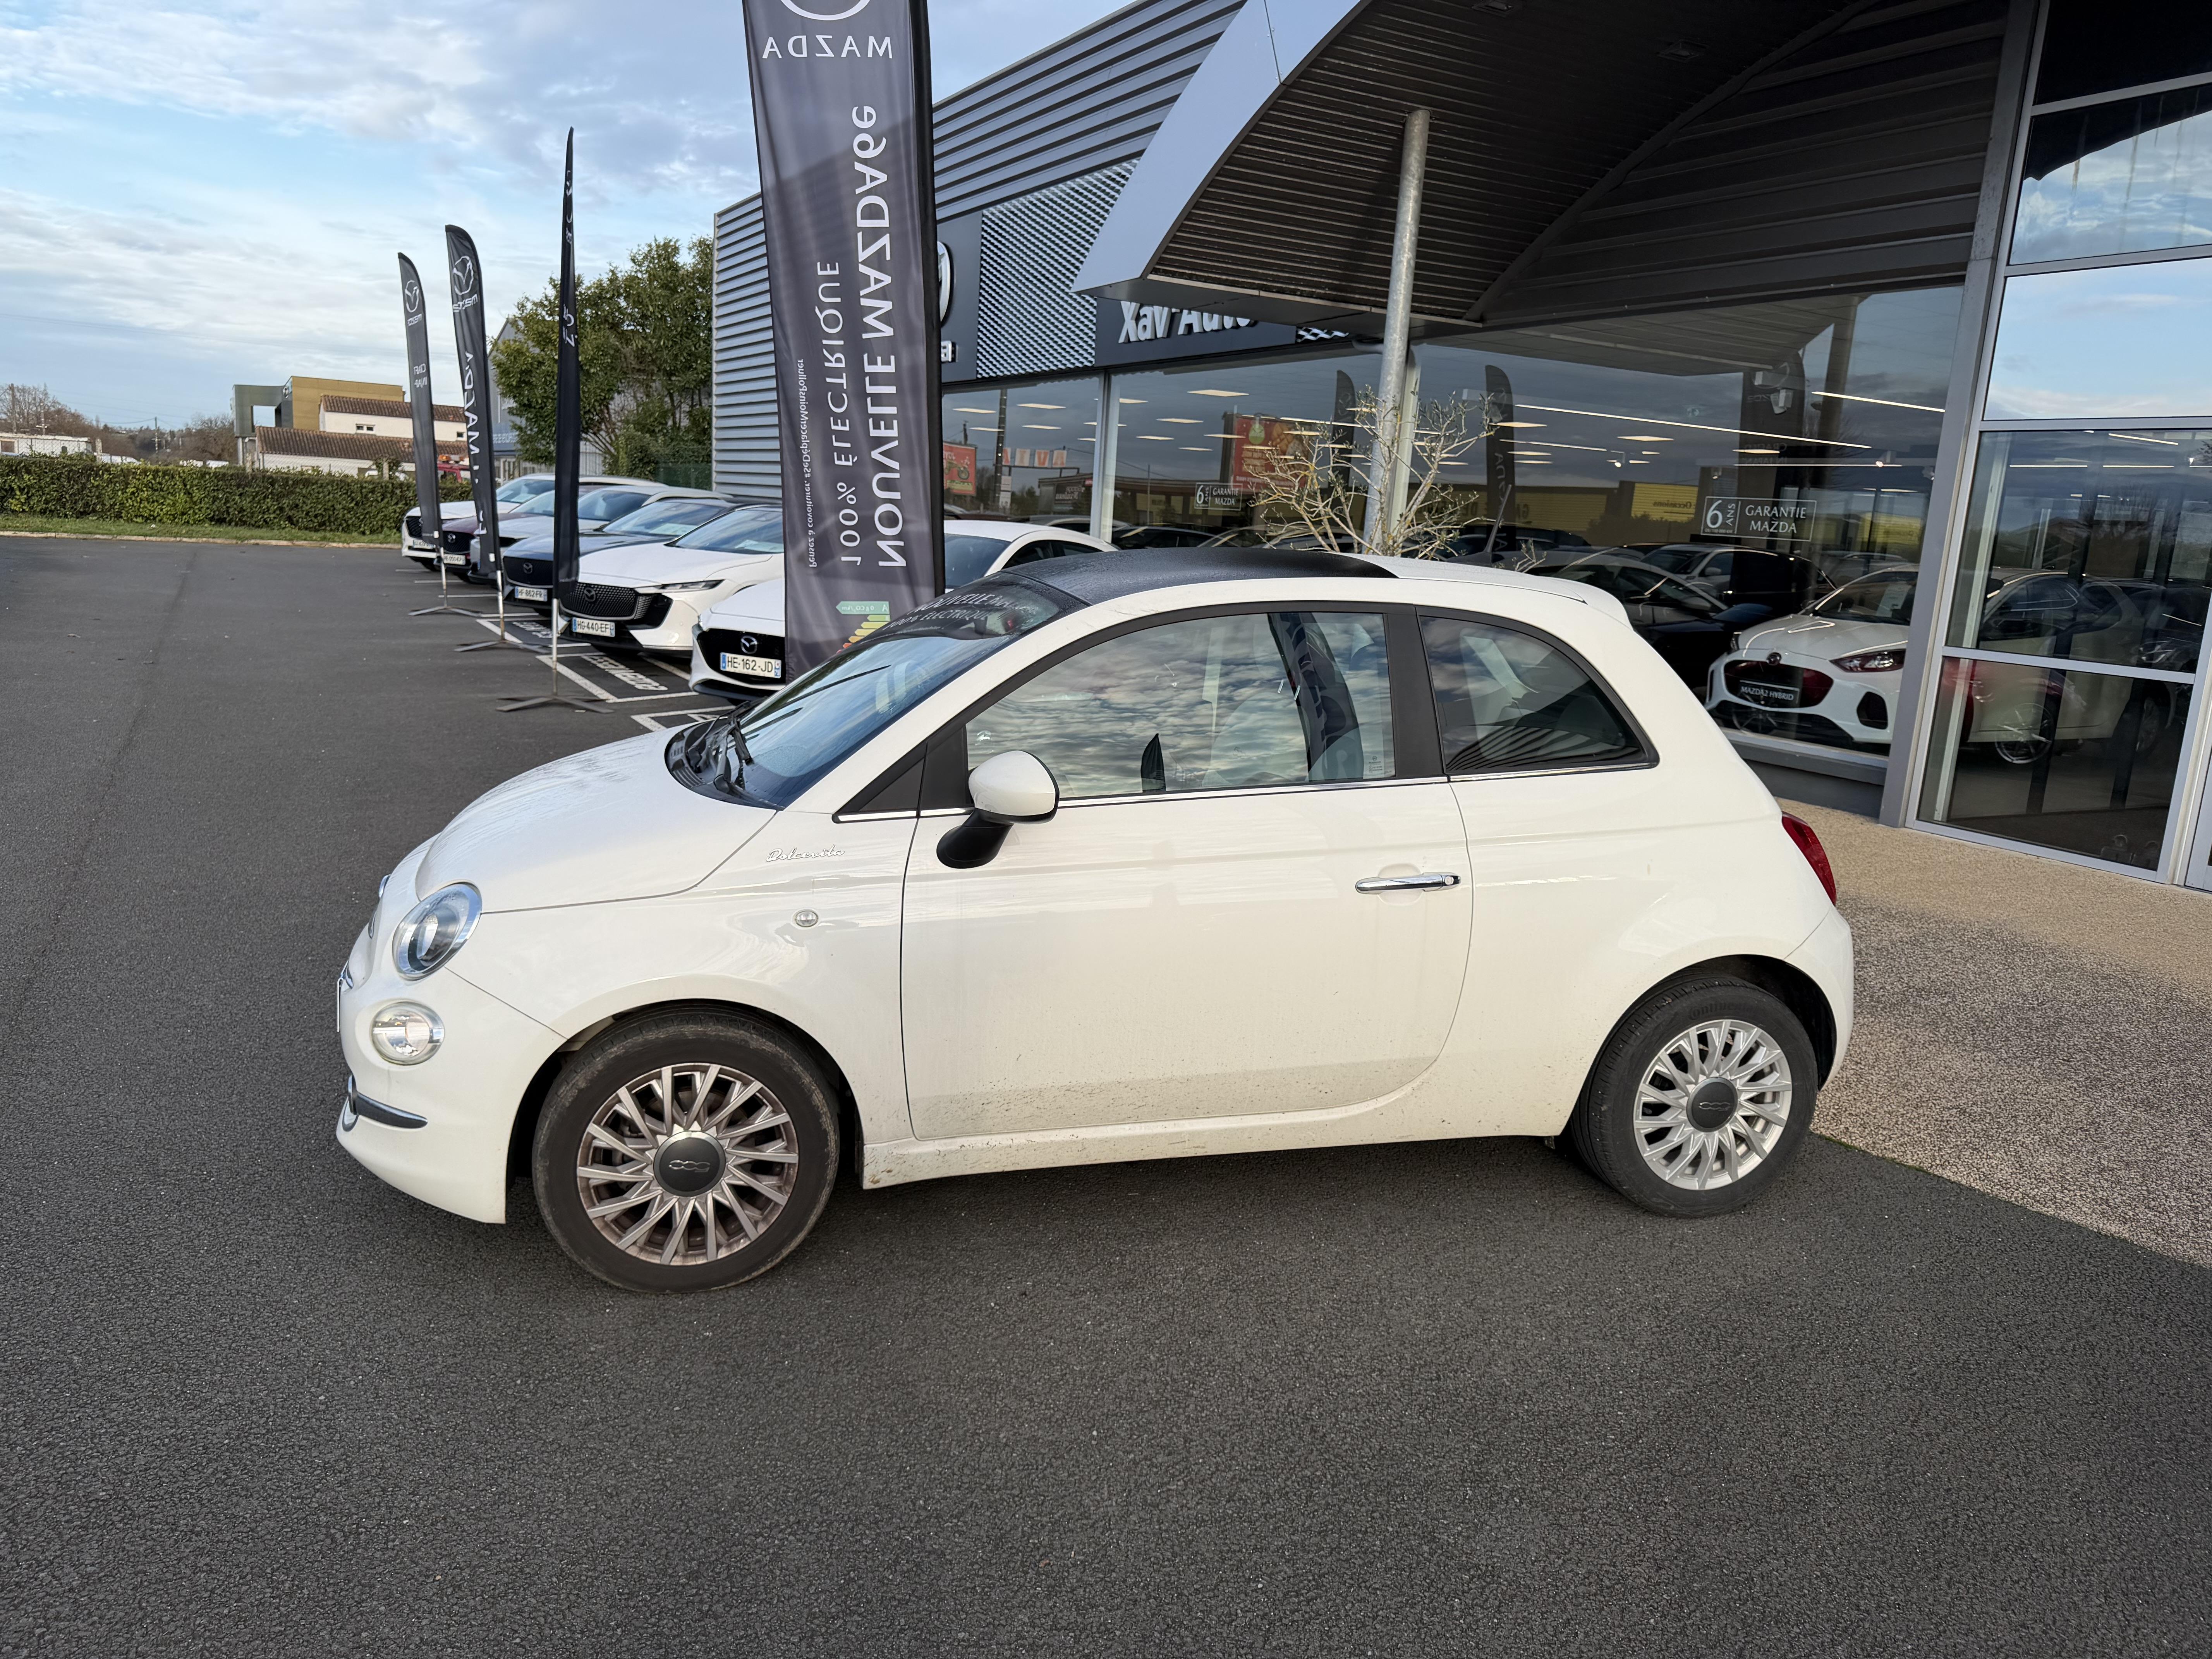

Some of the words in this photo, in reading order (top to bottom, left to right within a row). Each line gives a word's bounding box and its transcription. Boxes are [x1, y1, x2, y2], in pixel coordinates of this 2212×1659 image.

[1118, 301, 1252, 343] Xav-Au
[1196, 485, 1204, 504] 6
[1212, 488, 1239, 496] GARANTIE
[1214, 497, 1235, 506] MAZDA
[1706, 500, 1722, 528] 6
[1726, 503, 1736, 526] ANS
[1745, 505, 1807, 519] GARANTIE
[1749, 520, 1797, 534] MAZDA
[1741, 686, 1768, 697] MAZDA2
[1769, 691, 1794, 701] HYBRID
[766, 844, 845, 862] Dolcevita
[1688, 1001, 1756, 1020] Continen
